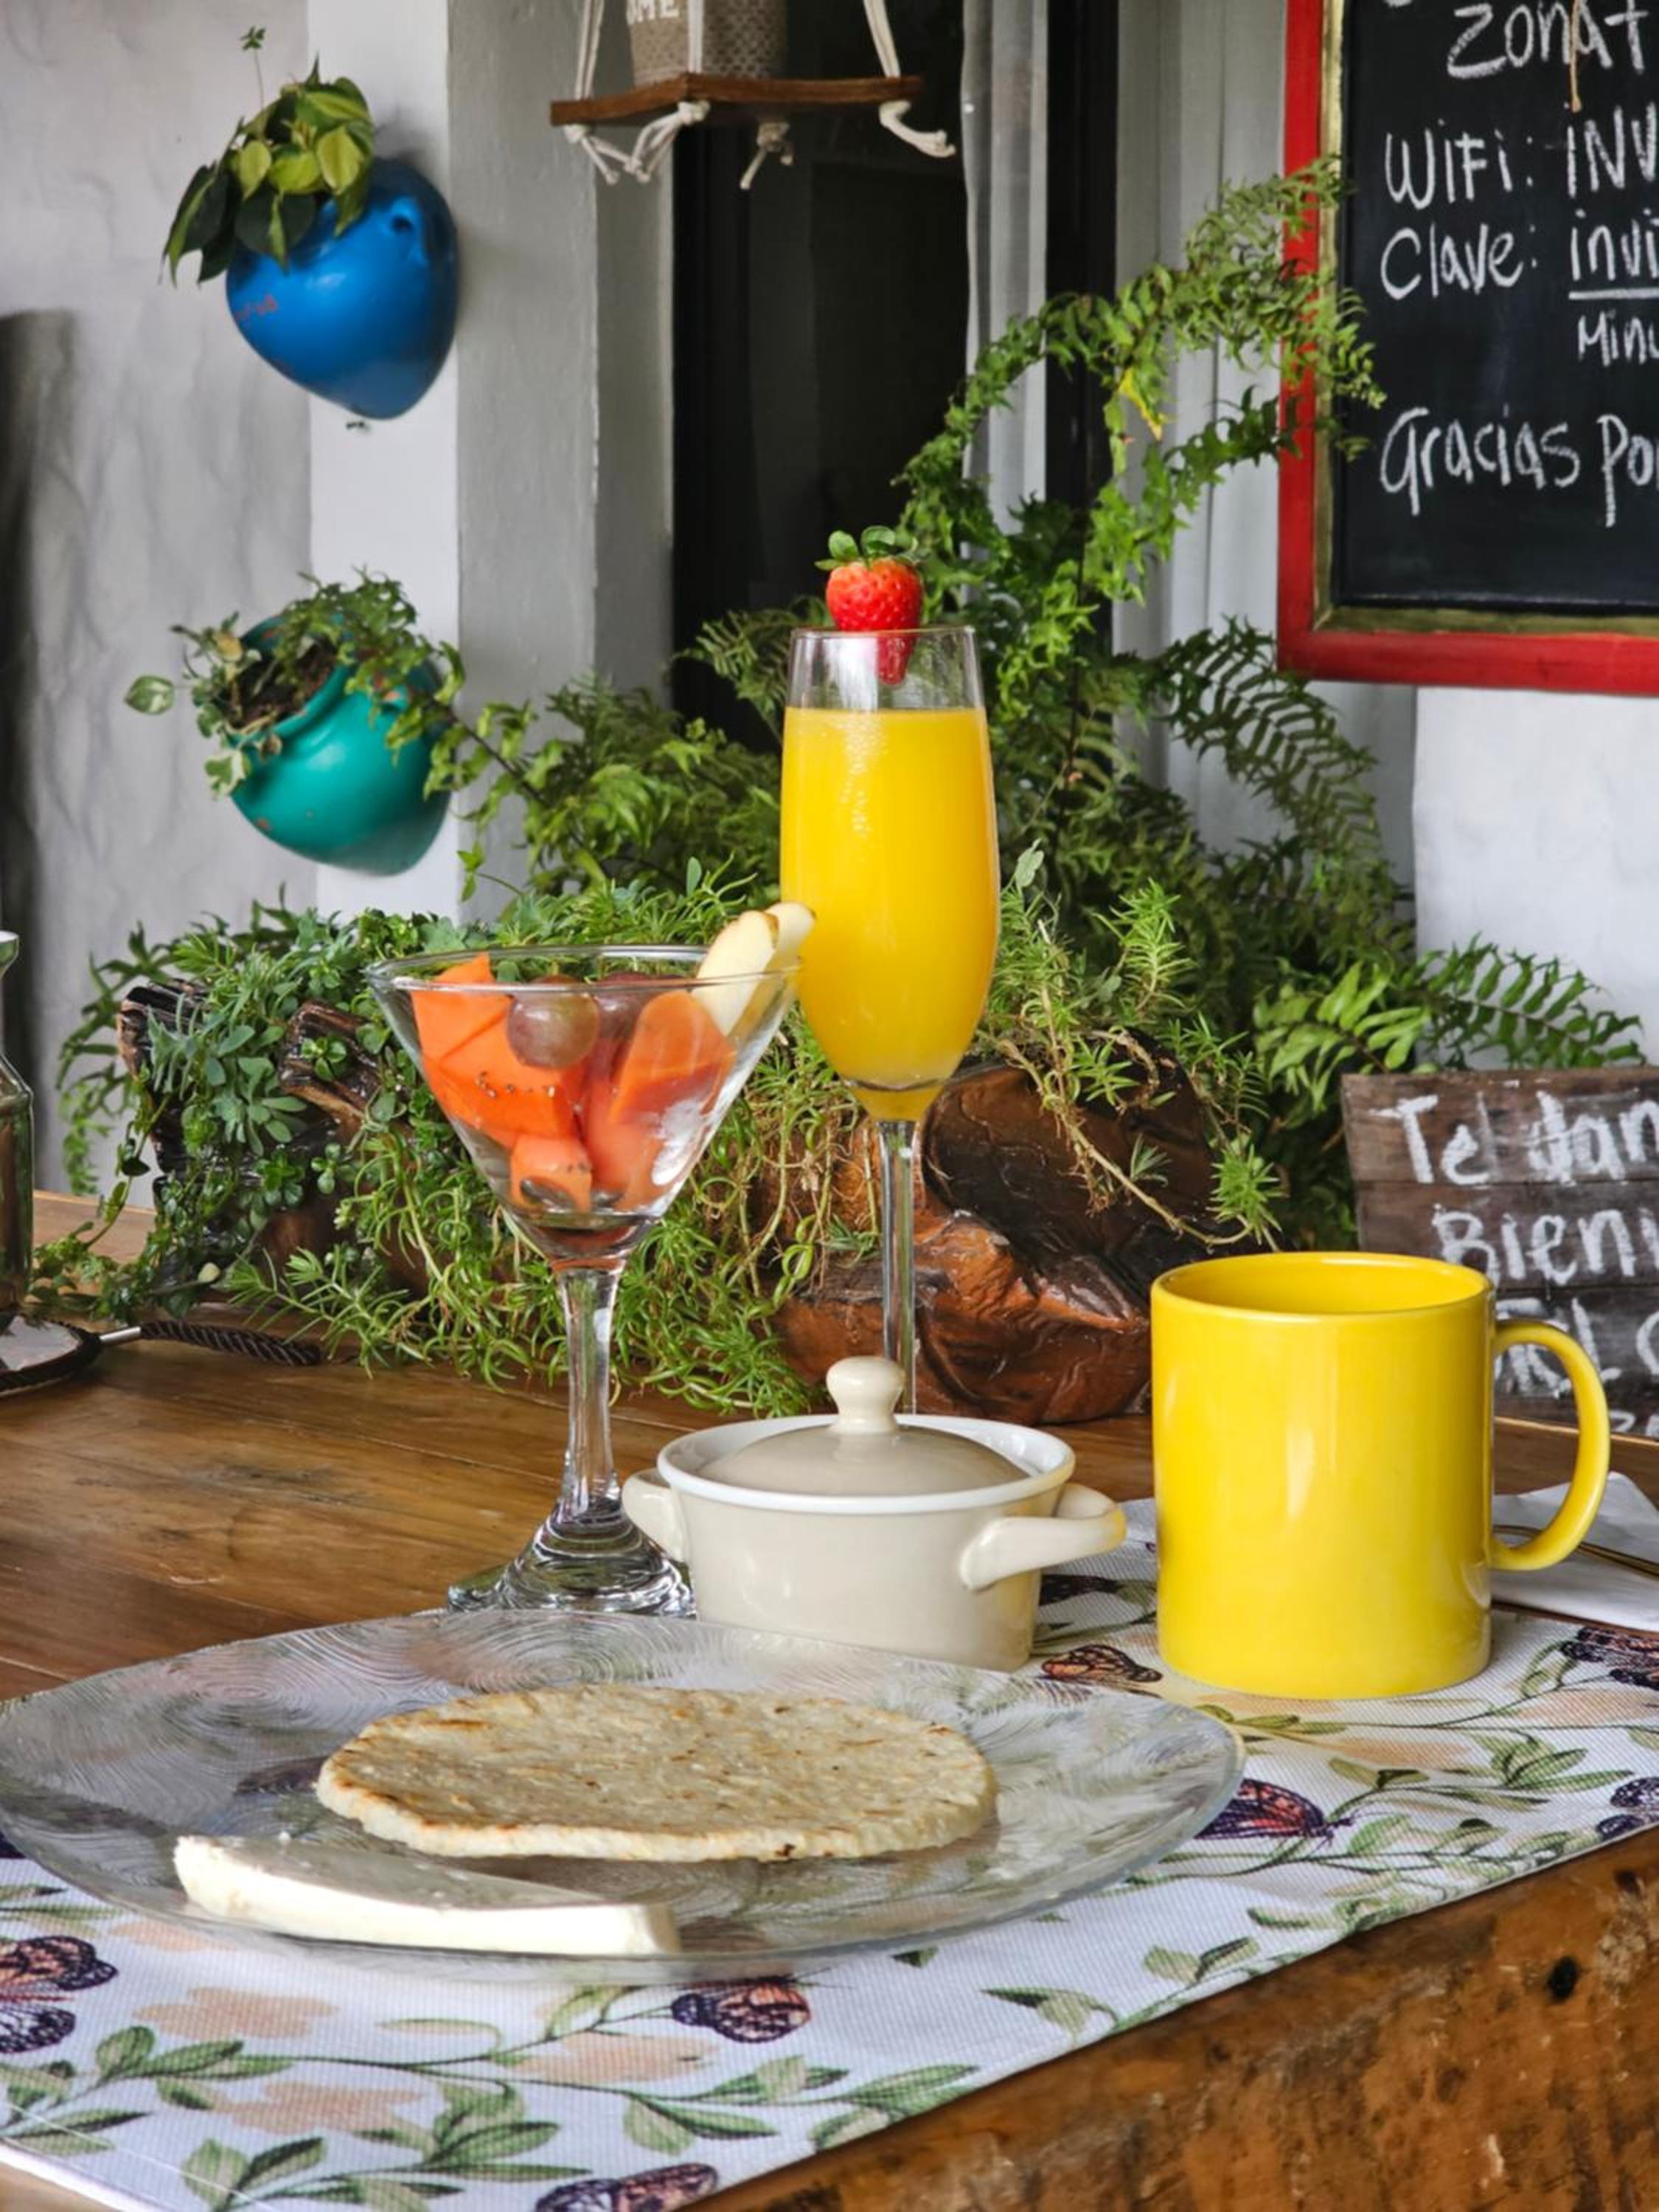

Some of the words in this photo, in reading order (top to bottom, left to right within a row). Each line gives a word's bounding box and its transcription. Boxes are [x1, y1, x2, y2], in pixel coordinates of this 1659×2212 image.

[1380, 223, 1538, 299] Clave:
[1571, 209, 1659, 281] invi
[1596, 414, 1659, 529] Po
